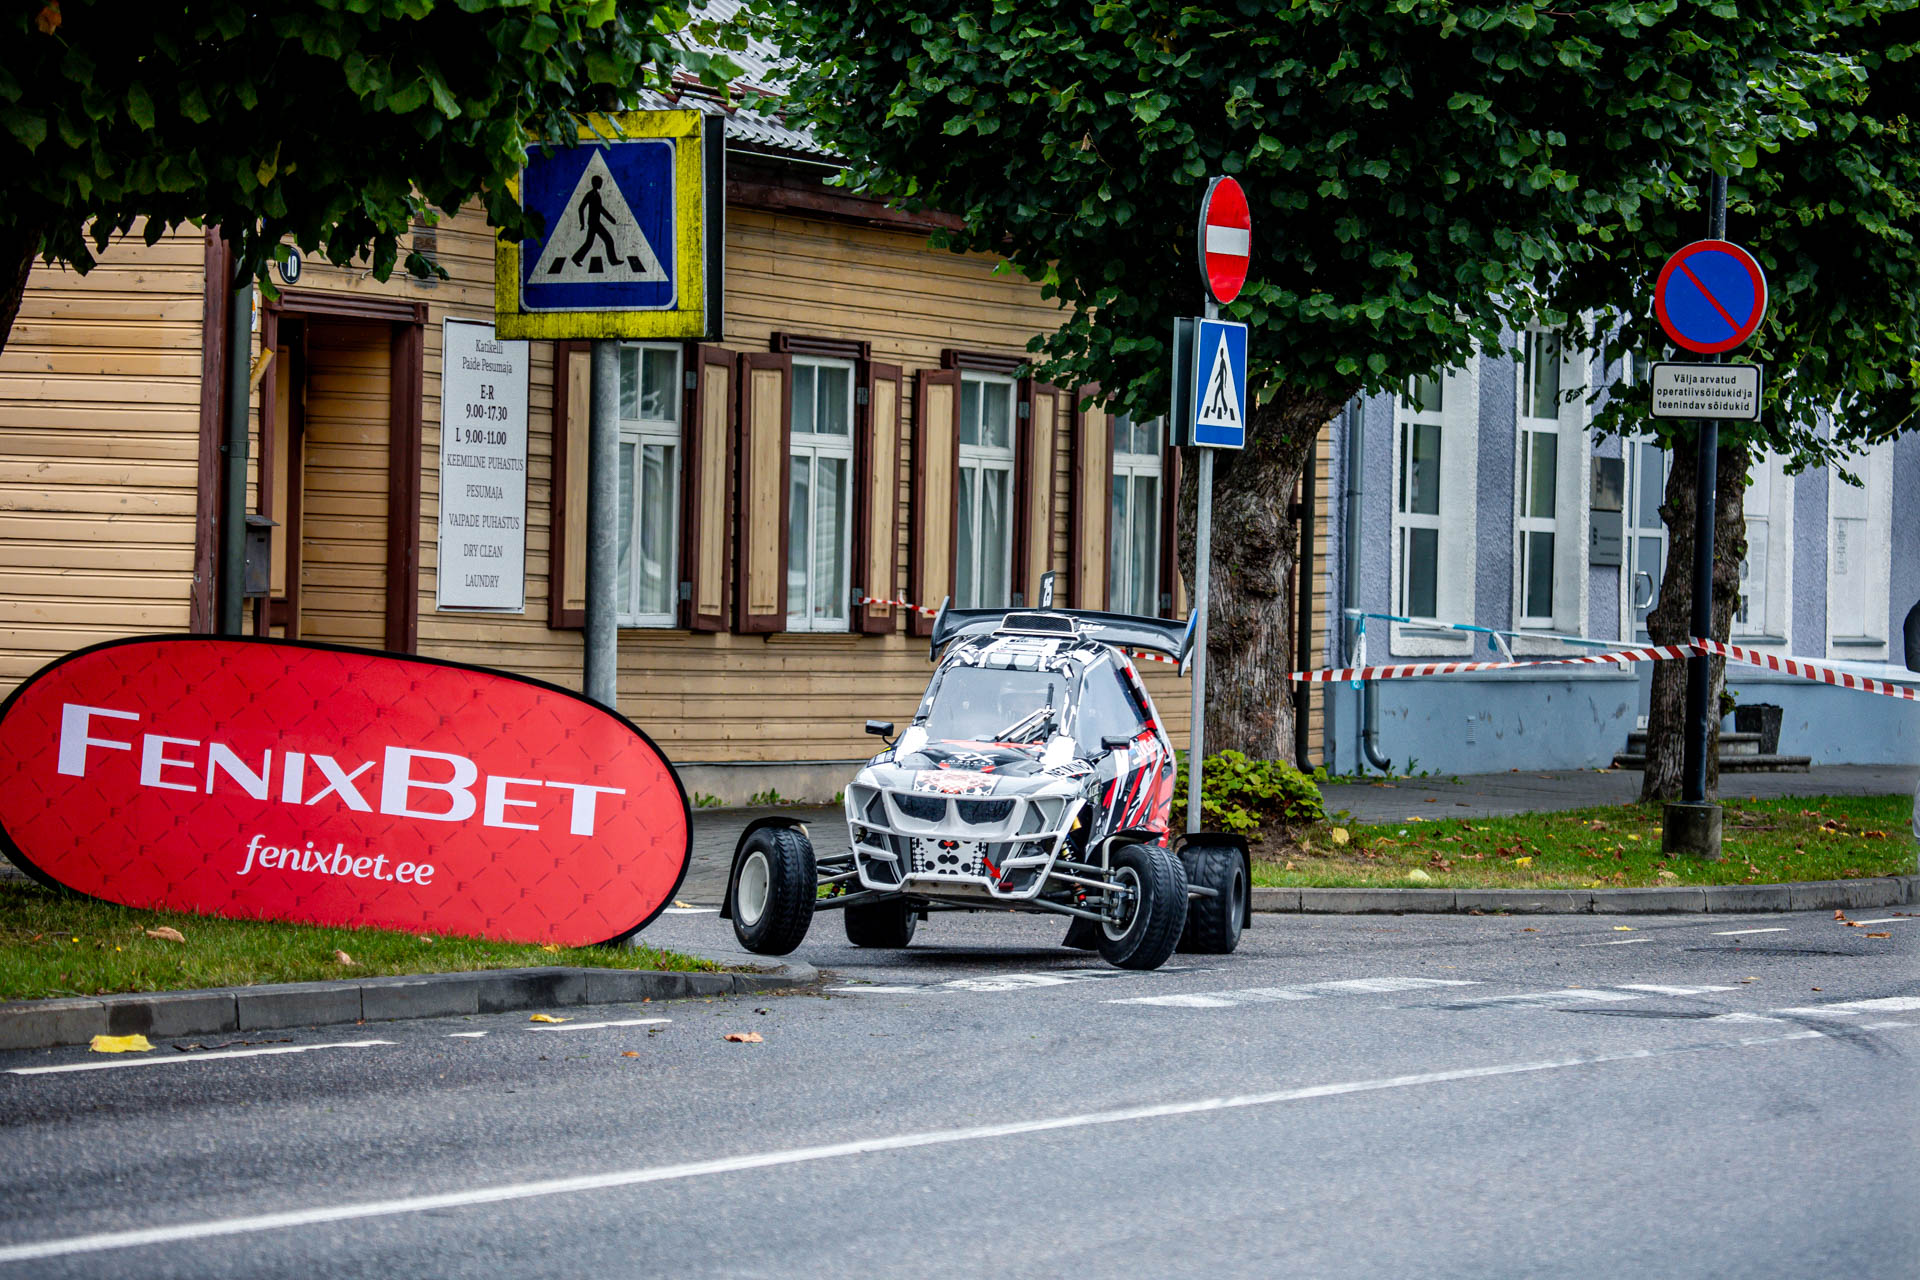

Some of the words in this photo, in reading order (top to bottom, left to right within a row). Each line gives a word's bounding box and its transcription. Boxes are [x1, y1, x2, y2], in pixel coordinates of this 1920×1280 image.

[287, 255, 298, 277] 10
[462, 356, 481, 370] Paide
[481, 358, 513, 376] Pesumaja
[1674, 374, 1698, 385] Välja
[1700, 376, 1737, 385] arvatud
[480, 384, 495, 400] E-R
[1656, 387, 1743, 398] operatiivsõidukid
[1743, 389, 1753, 399] ja
[1658, 401, 1705, 410] teenindav
[1707, 401, 1750, 411] sõidukid
[455, 427, 461, 442] L
[446, 453, 486, 469] KEEMILINE
[488, 456, 524, 471] PUHASTUS
[466, 484, 503, 501] PESUMAJA
[448, 513, 480, 528] VAIPADE
[482, 515, 520, 530] PUHASTUS
[463, 543, 479, 557] DRY
[479, 545, 503, 558] CLEAN
[465, 574, 500, 588] LAUNDRY
[236, 833, 435, 887] fenixbet.ee
